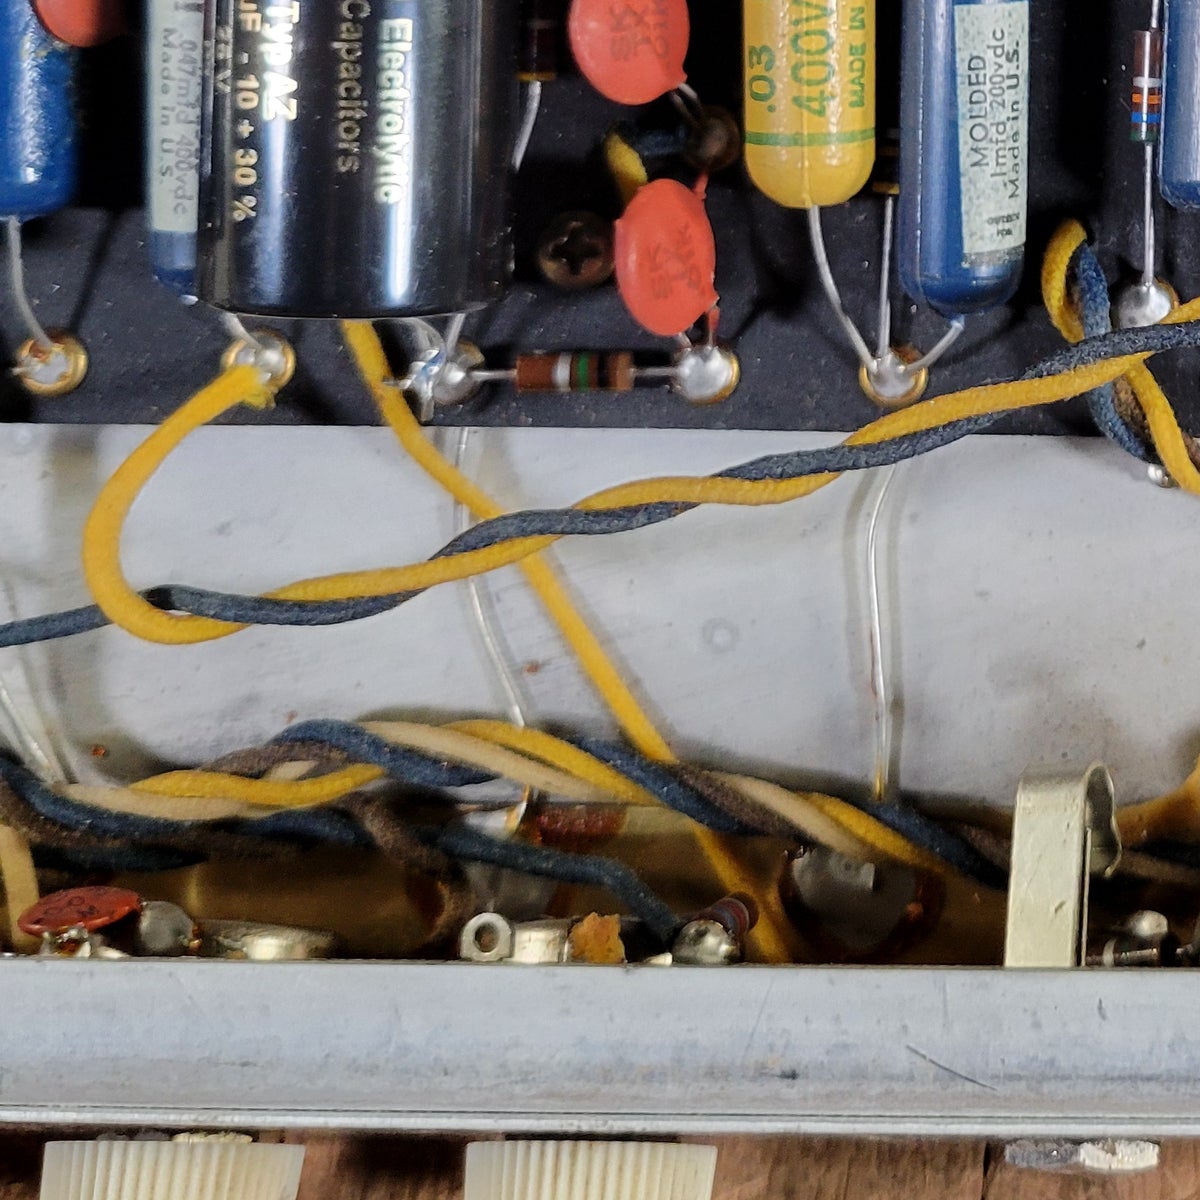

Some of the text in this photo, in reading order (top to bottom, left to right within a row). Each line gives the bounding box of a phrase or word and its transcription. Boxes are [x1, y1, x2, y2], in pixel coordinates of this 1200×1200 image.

[260, 1, 301, 122] Typ AZ
[848, 6, 865, 31] IN
[159, 27, 175, 184] Made in U.S.
[236, 74, 259, 109] 10
[747, 45, 776, 113] .03
[848, 42, 865, 108] MADE
[968, 55, 989, 168] MOLDED
[990, 27, 1008, 187] .1mfd 200vdc
[1006, 40, 1021, 199] Made in U.S.
[234, 148, 258, 186] 30
